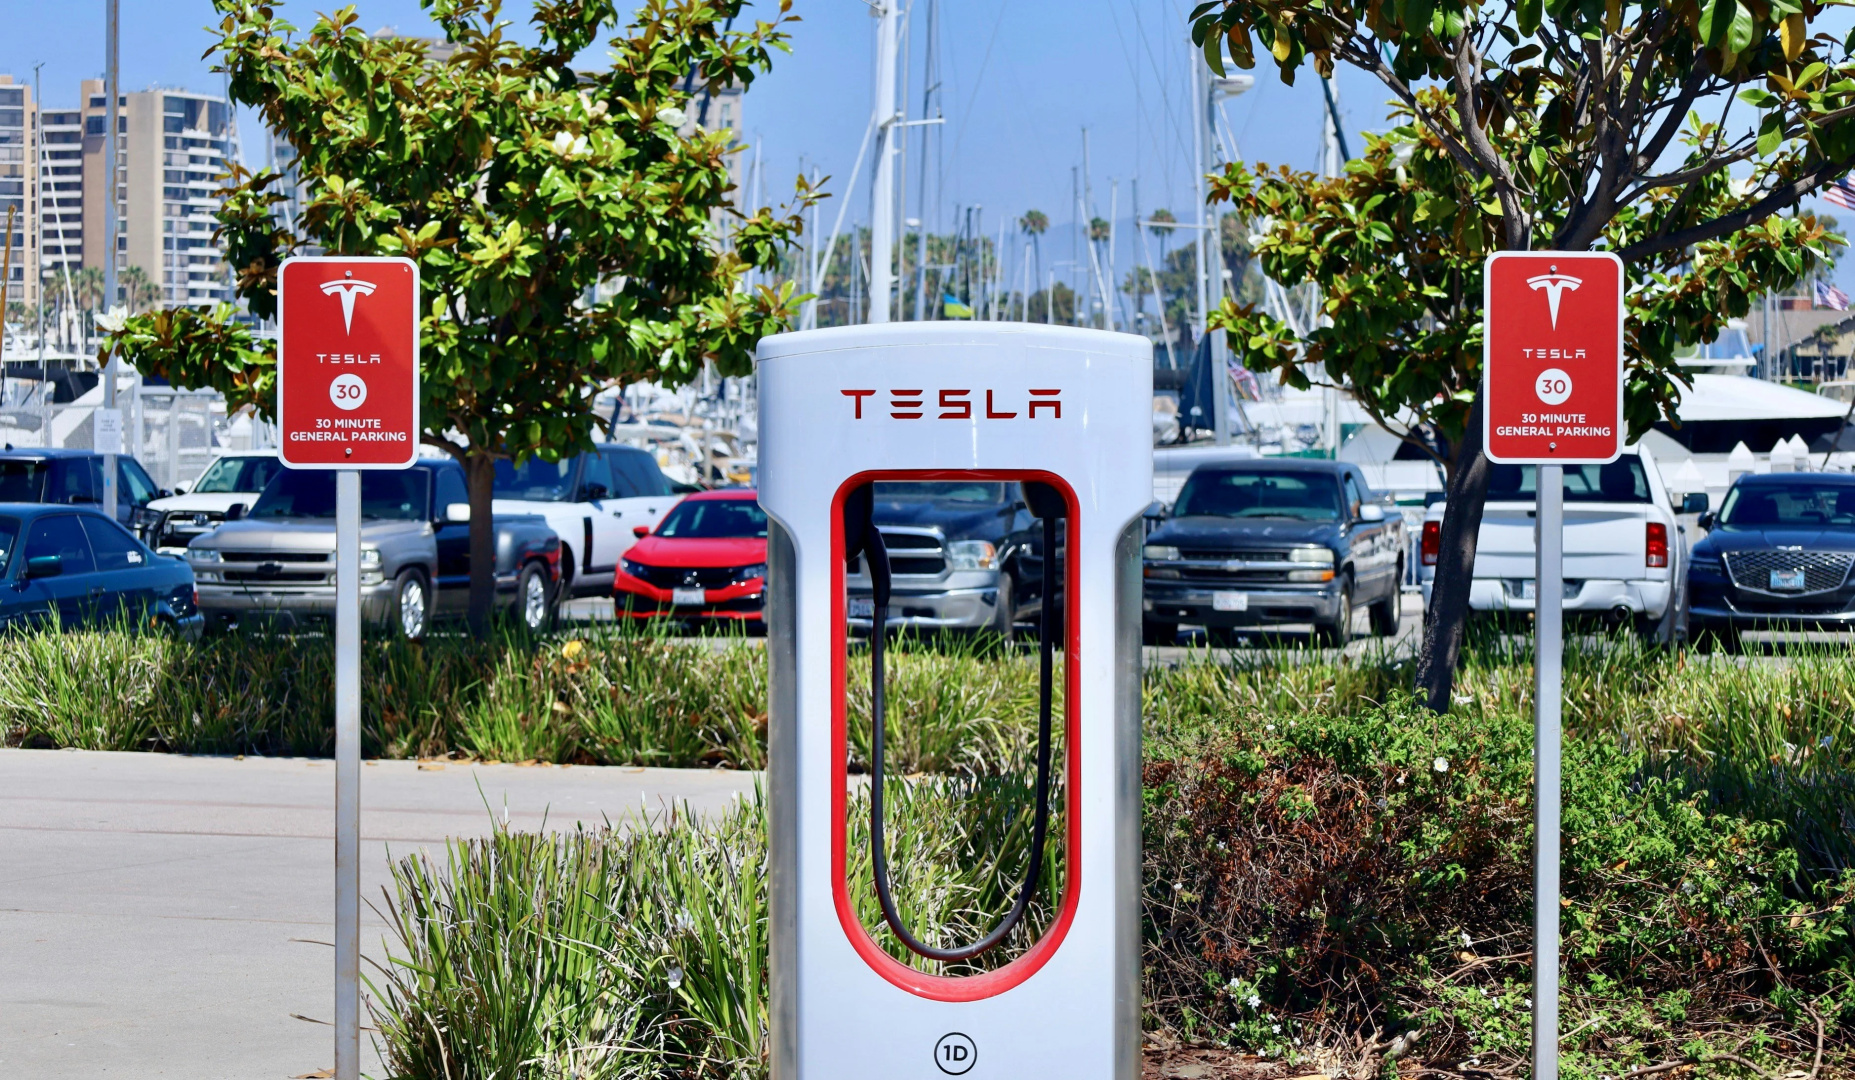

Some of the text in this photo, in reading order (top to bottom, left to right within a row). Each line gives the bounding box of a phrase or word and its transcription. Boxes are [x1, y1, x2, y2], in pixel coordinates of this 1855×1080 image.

[316, 353, 381, 364] TESLA
[1522, 348, 1586, 359] TESLA
[336, 384, 361, 400] 30
[1541, 379, 1567, 395] 30
[840, 389, 1062, 420] TESLA
[315, 418, 381, 429] 30 MINUTE
[1521, 413, 1586, 424] 30 MINUTE
[290, 431, 407, 442] GENERAL PARKING
[1496, 426, 1611, 436] GENERAL PARKING
[943, 1044, 969, 1062] 1D
